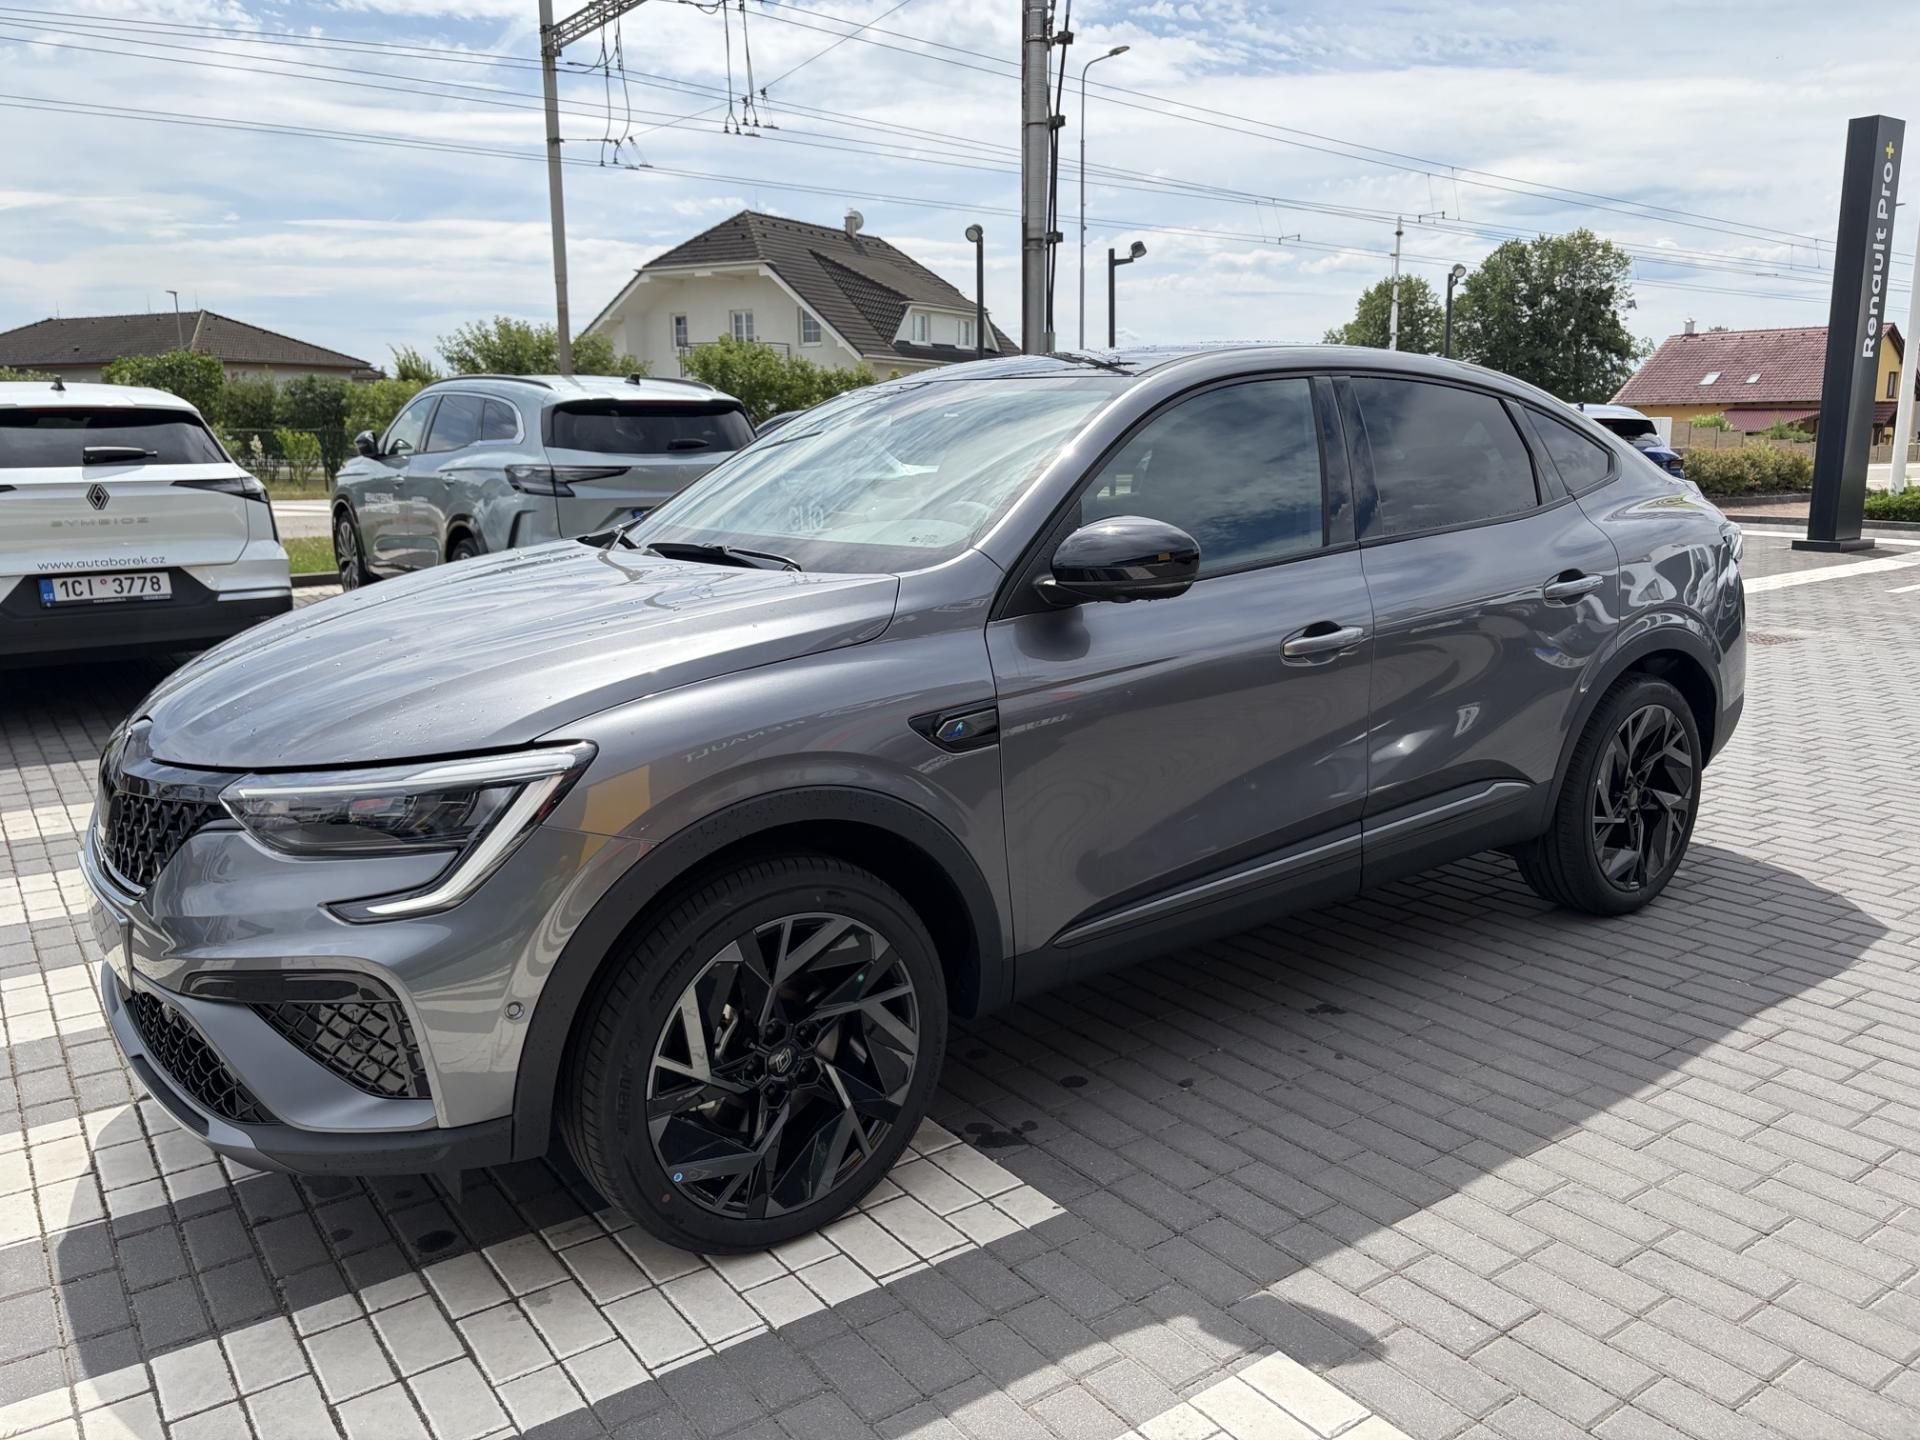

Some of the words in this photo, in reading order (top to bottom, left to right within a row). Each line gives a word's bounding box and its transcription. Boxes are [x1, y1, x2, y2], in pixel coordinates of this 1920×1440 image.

[1862, 228, 1888, 358] Renault
[1876, 141, 1895, 220] Pro+
[60, 578, 94, 598] 1CI
[112, 575, 162, 595] 3778
